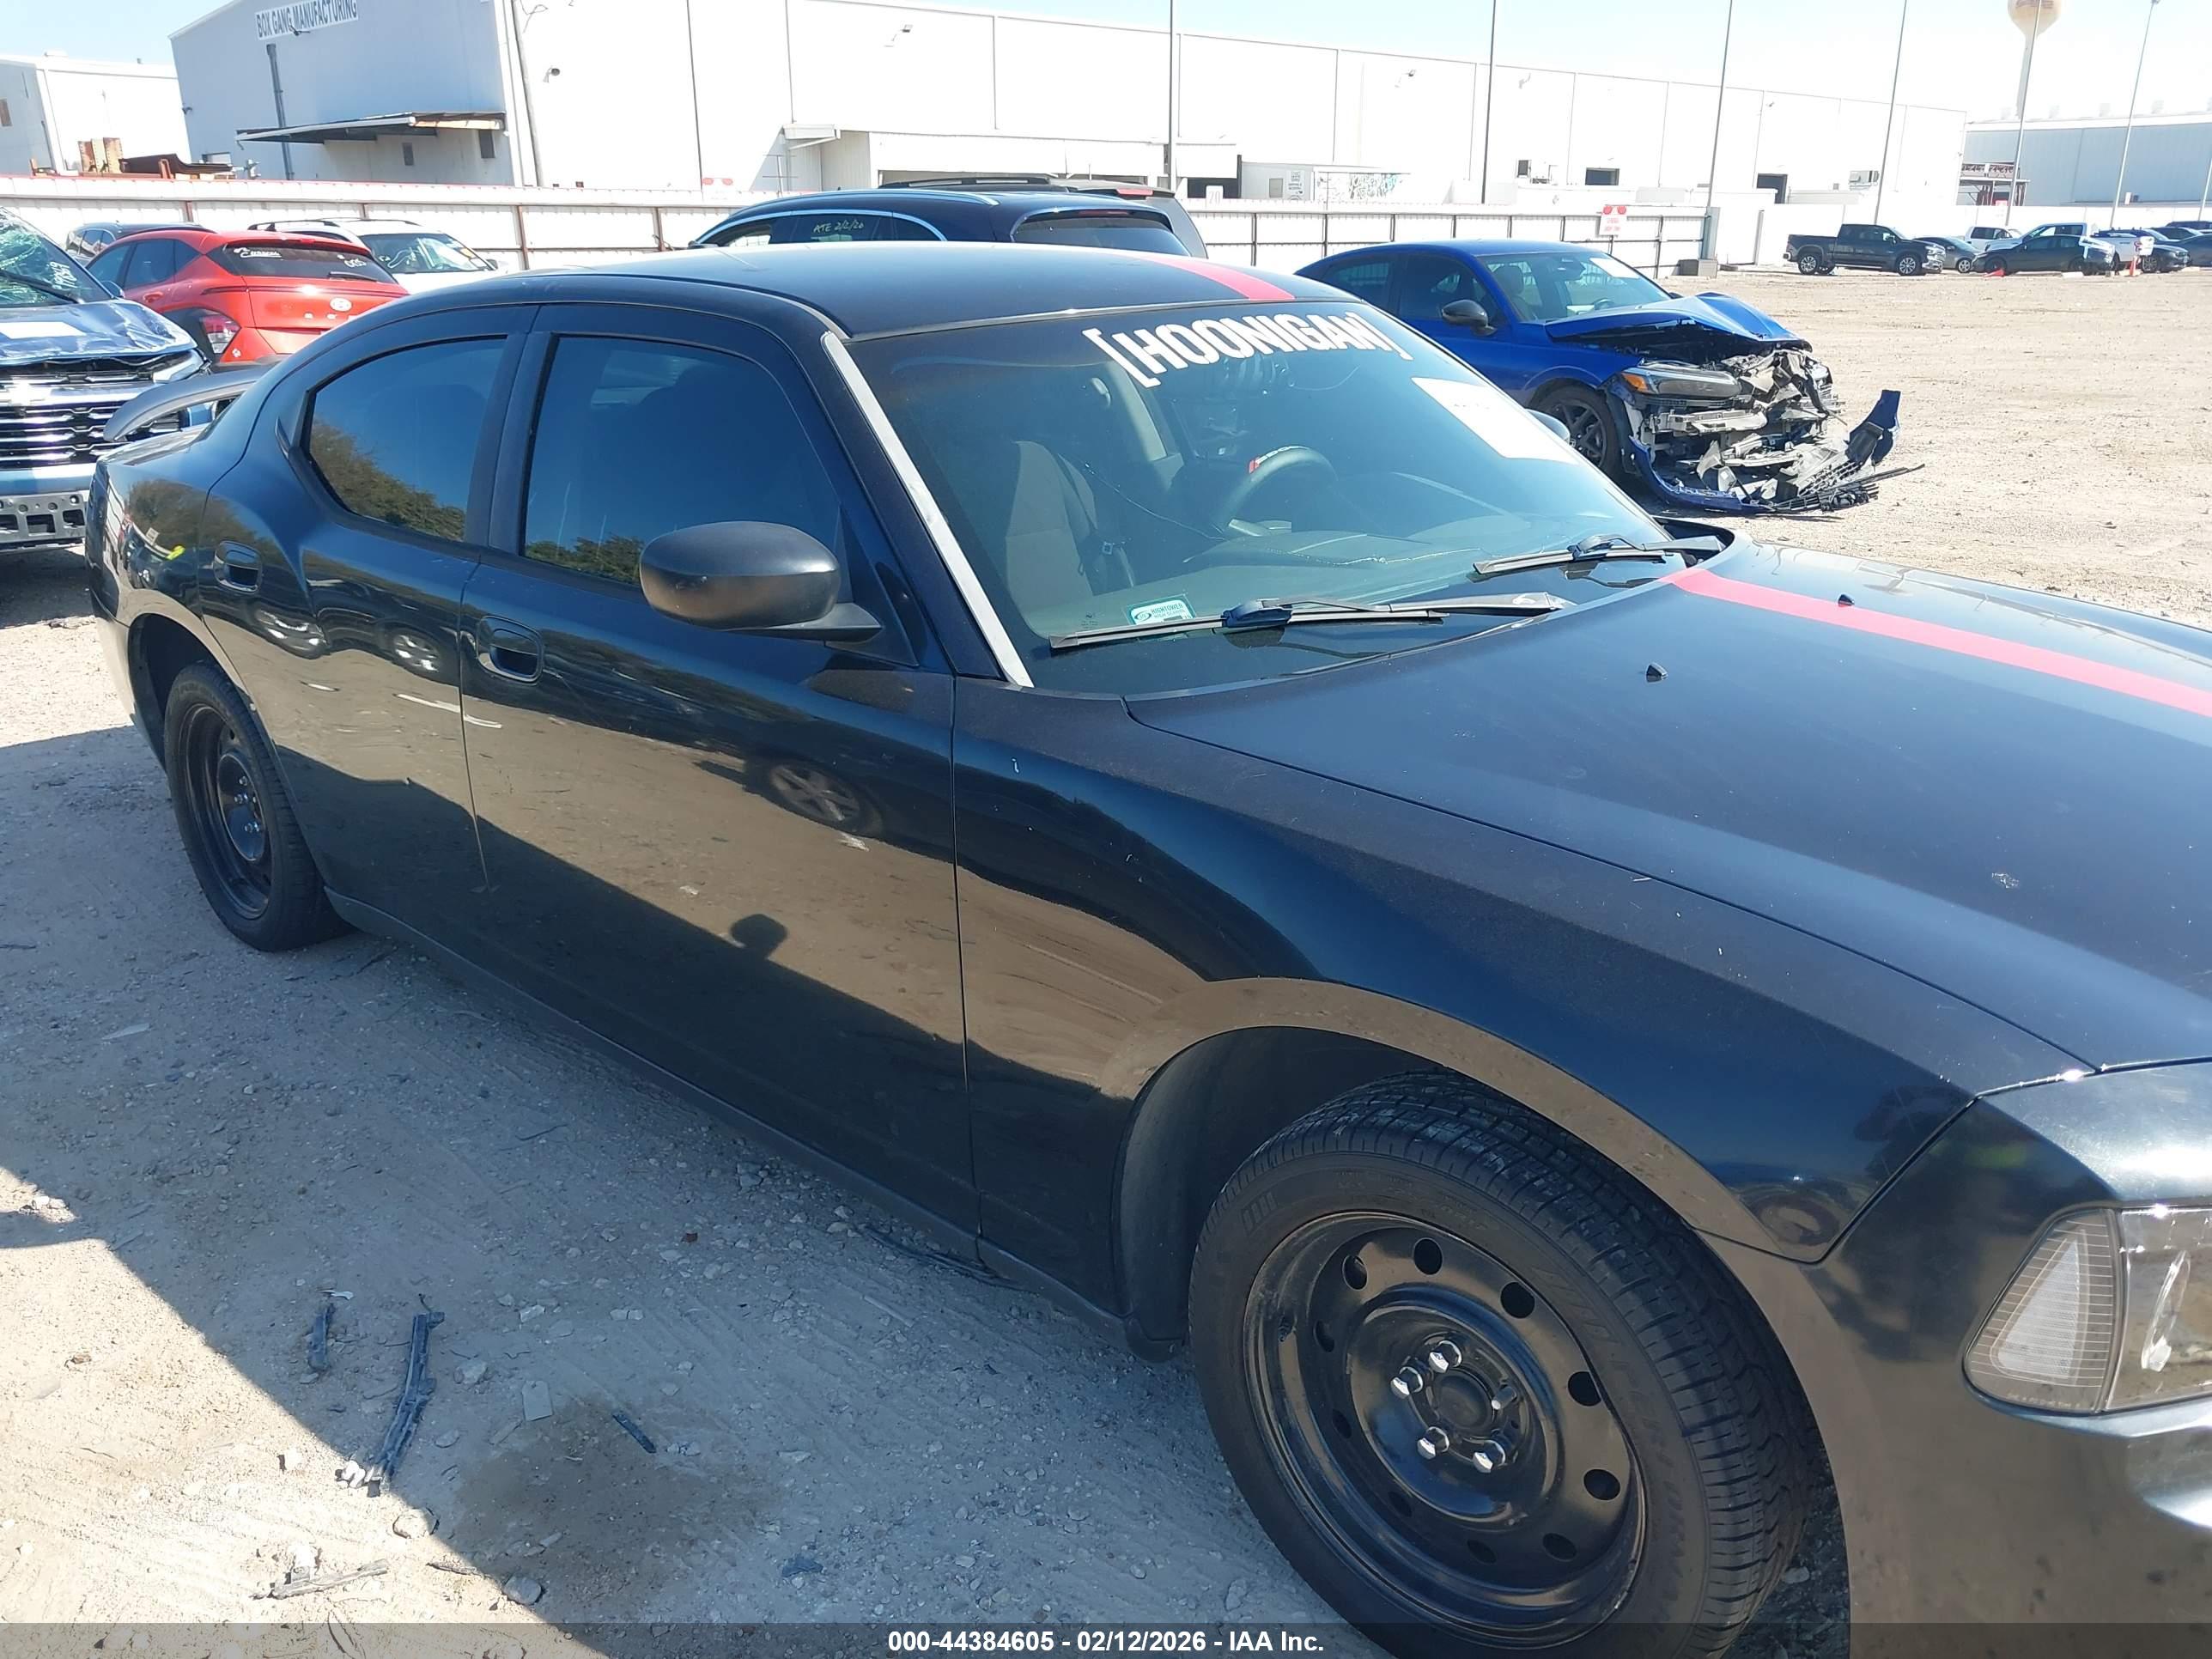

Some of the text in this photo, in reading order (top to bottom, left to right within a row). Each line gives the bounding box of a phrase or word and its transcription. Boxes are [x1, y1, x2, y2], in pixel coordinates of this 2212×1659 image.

[256, 0, 357, 38] BOX GANG MANUFACTURING
